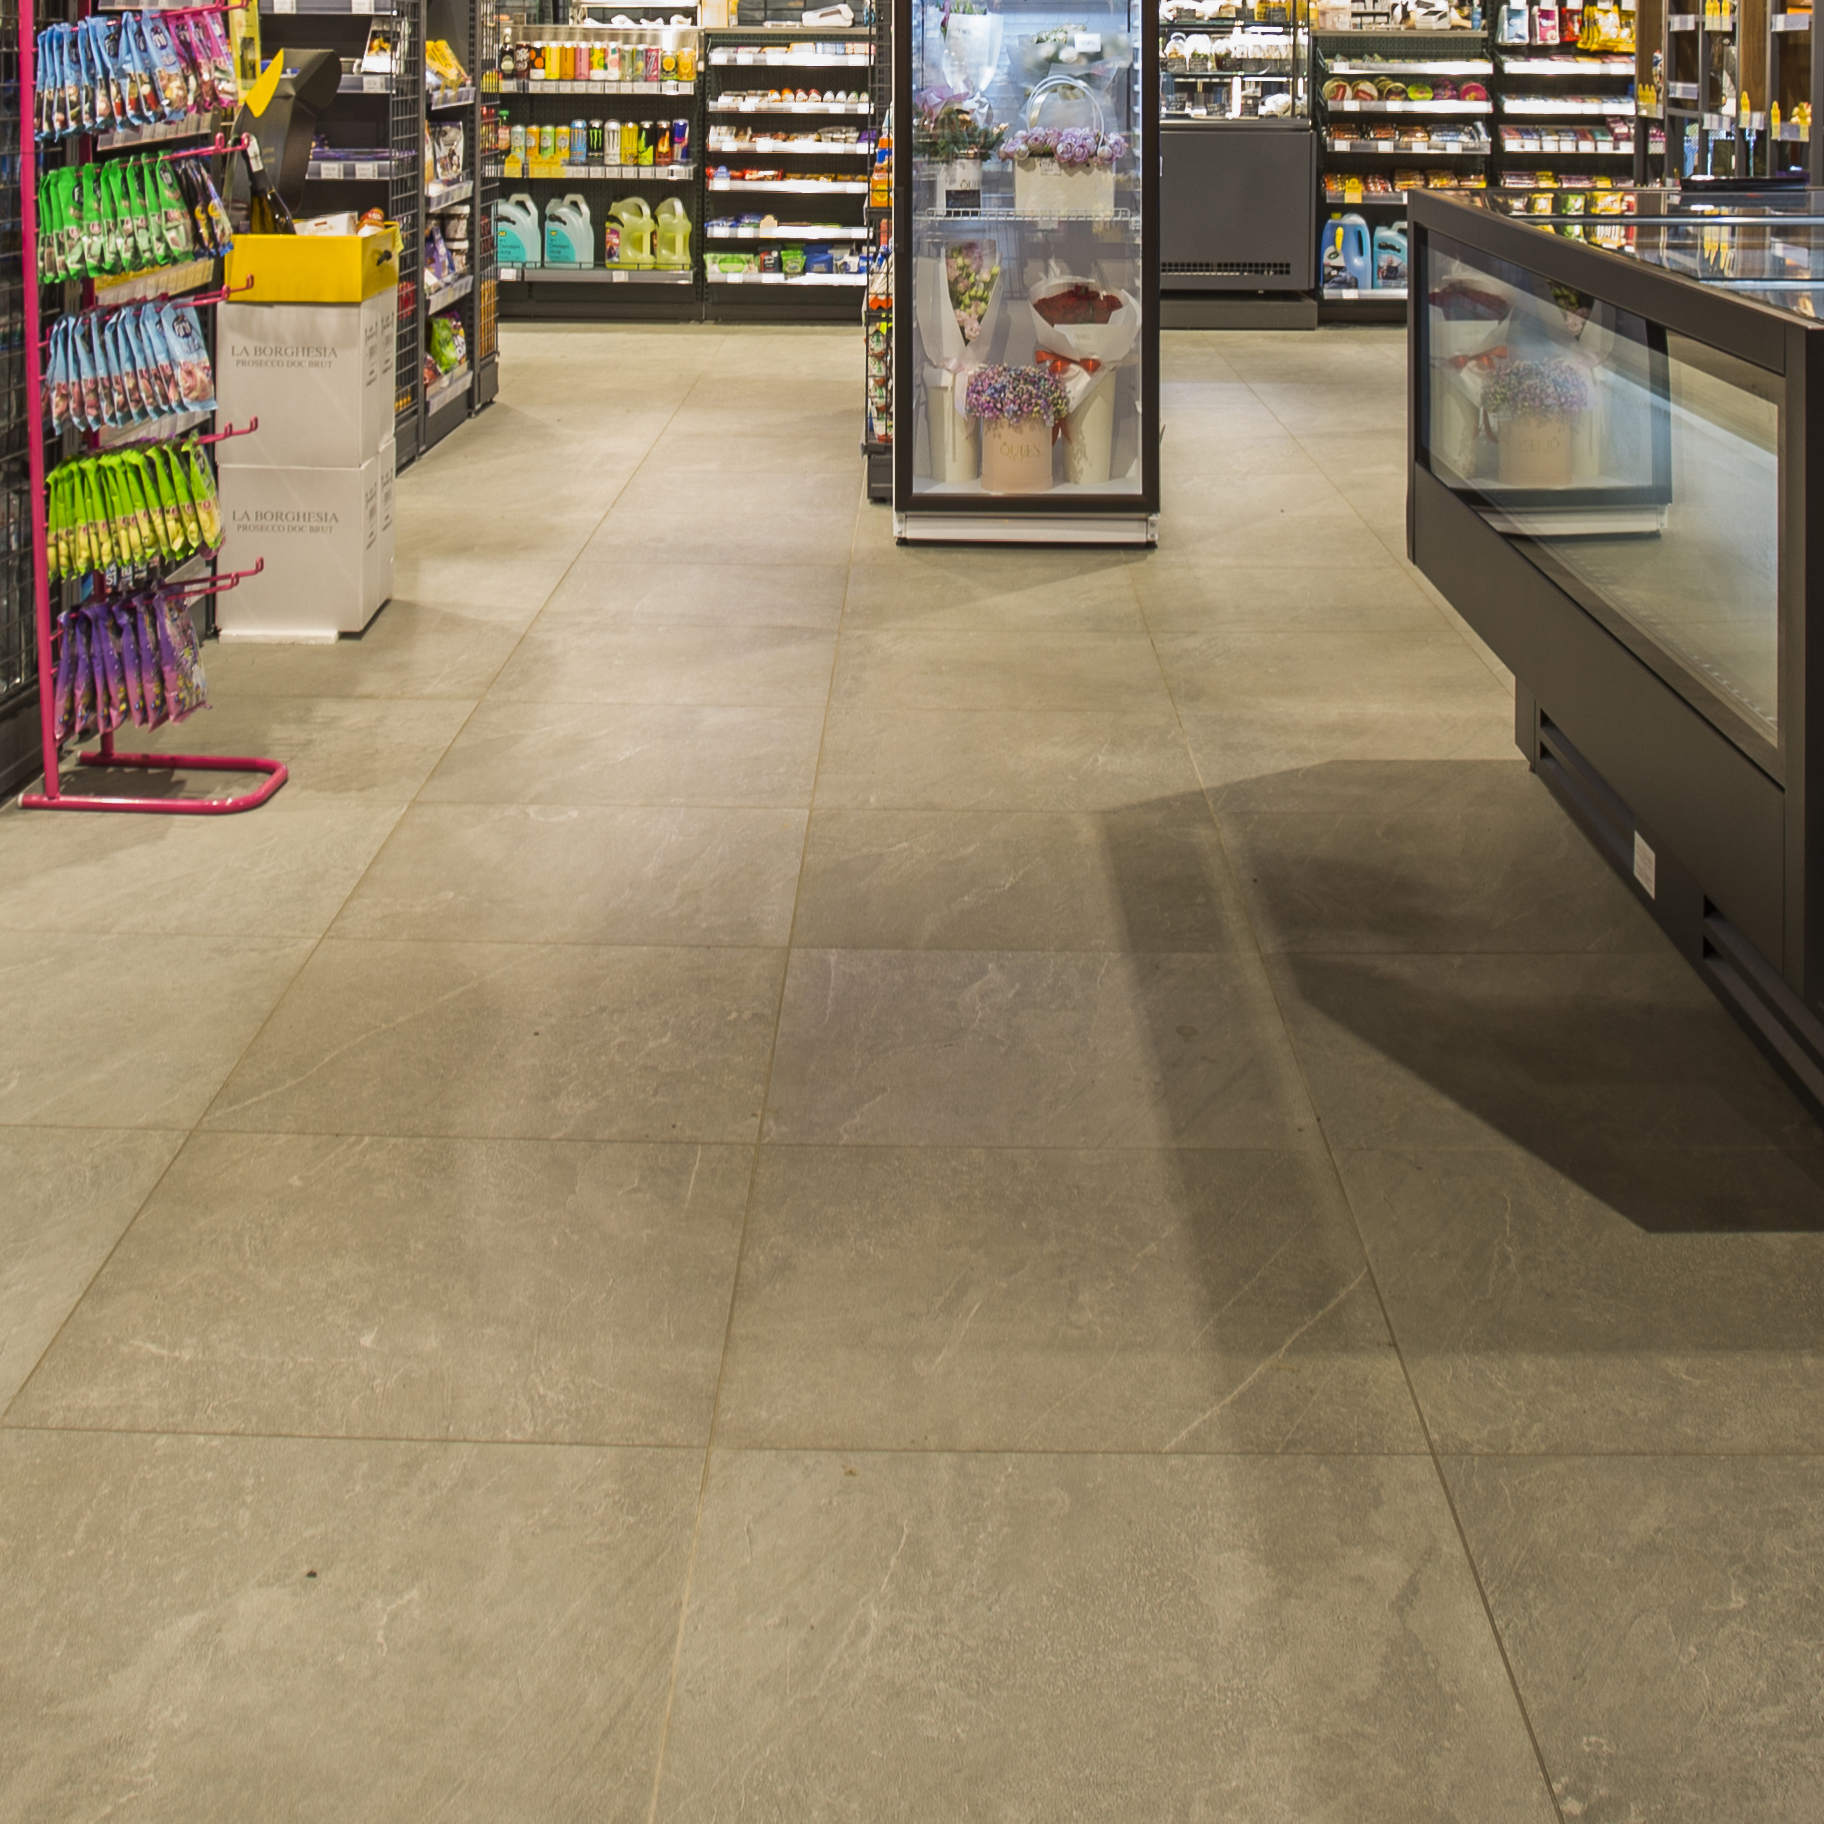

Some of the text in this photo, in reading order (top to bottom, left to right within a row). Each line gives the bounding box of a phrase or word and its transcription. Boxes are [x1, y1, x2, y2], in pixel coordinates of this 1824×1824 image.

[231, 346, 337, 358] LA BORGHESIA
[236, 359, 332, 369] PROSECCO DOC BRUT
[232, 510, 339, 523] LA BORGHESIA
[237, 524, 333, 534] PROSECCO DOC BRUT
